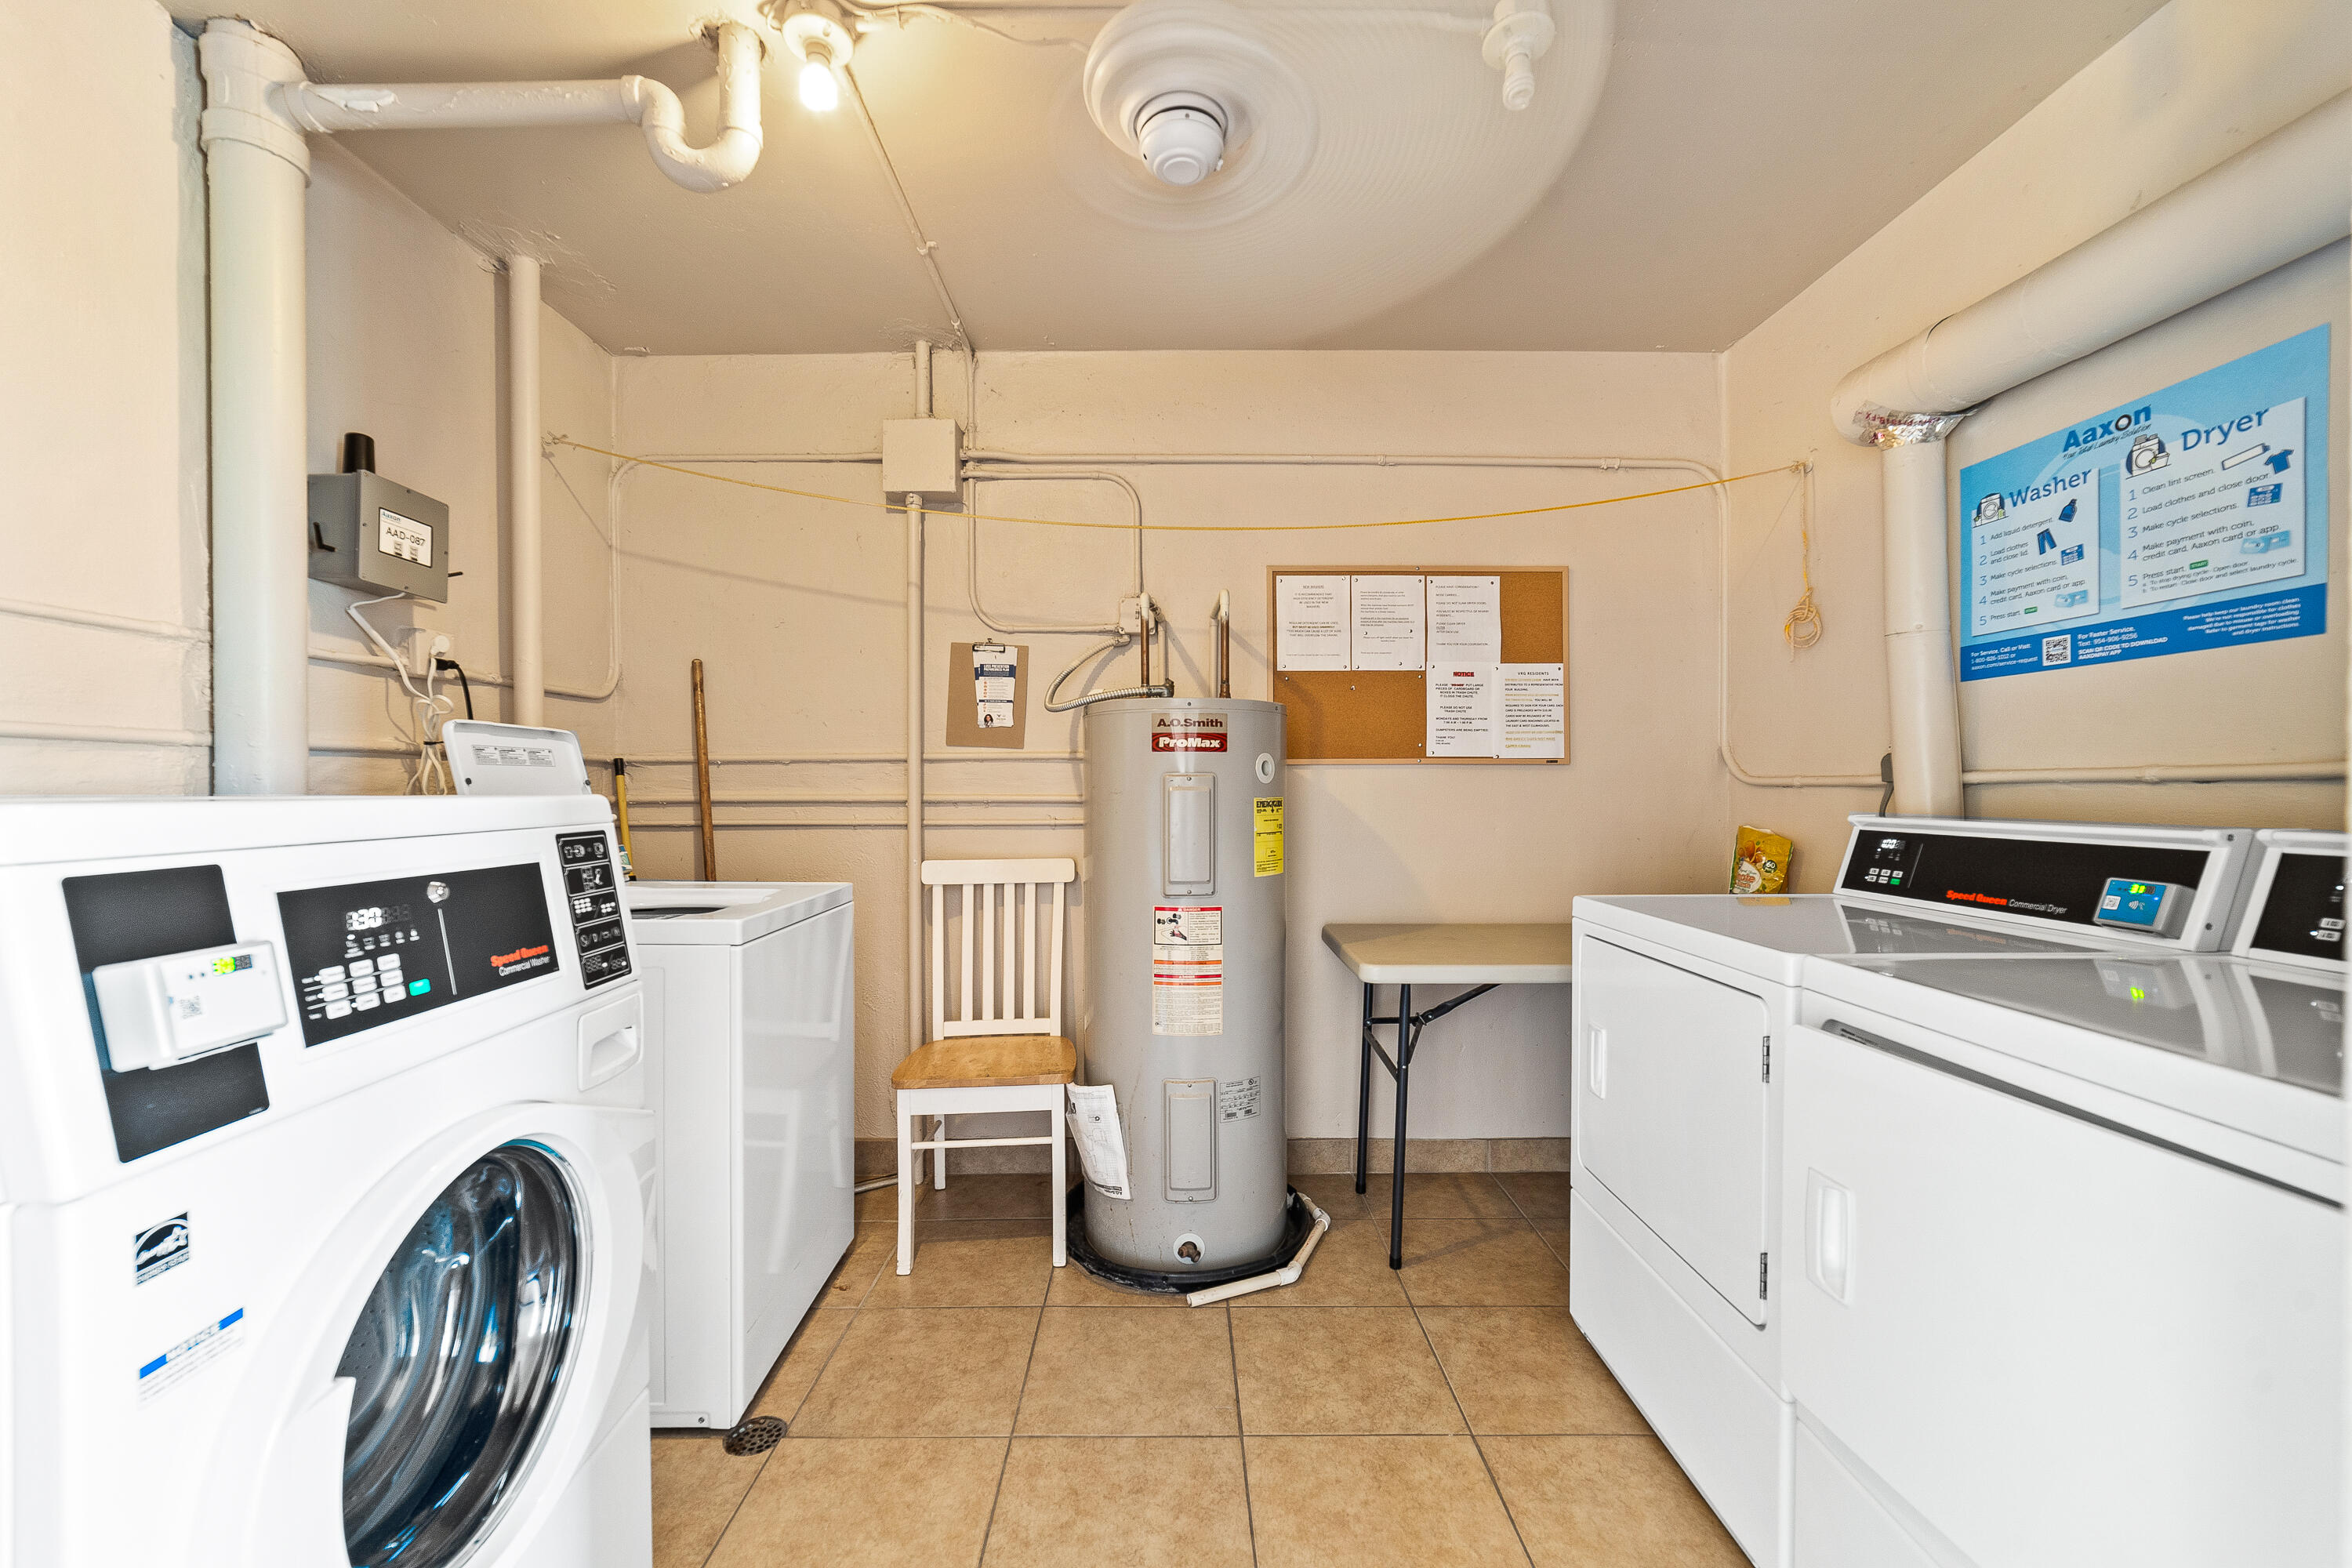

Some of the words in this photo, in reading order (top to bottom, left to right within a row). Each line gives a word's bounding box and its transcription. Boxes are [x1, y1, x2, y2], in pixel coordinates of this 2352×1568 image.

[2063, 406, 2151, 451] Aaxon
[2181, 409, 2267, 450] Dryer
[2009, 470, 2090, 506] Washer
[2129, 489, 2136, 500] 1
[2142, 483, 2165, 494] Clean
[2168, 477, 2180, 486] lint
[2127, 507, 2137, 519] 2
[2143, 503, 2162, 514] Load
[2165, 494, 2195, 506] clothes
[2198, 487, 2215, 497] and
[2218, 481, 2242, 492] close
[386, 527, 426, 546] AAD-087
[1980, 535, 1986, 545] 1
[2004, 527, 2020, 536] liquid
[2128, 526, 2137, 538] 3
[2143, 523, 2164, 532] Make
[2166, 516, 2188, 526] cycle
[2166, 532, 2204, 546] payment
[2208, 526, 2227, 535] with
[1980, 555, 1987, 565] 2
[1991, 547, 2005, 556] Load
[2006, 542, 2028, 551] clothes
[2127, 550, 2138, 559] 4
[2143, 550, 2165, 561] credit
[2191, 539, 2220, 549] Aaxon
[2222, 532, 2243, 542] card
[1980, 575, 1987, 585] 3
[2007, 582, 2034, 593] payment
[2129, 574, 2137, 586] 5
[1979, 595, 1987, 604] 4
[1980, 615, 1987, 626] 5
[2130, 637, 2168, 647] DOWNLOAD
[2078, 651, 2109, 659] AAXONPAY
[1157, 718, 1223, 728] A.O.Smith
[1158, 736, 1221, 749] ProMax
[1946, 890, 1976, 902] Speed
[1976, 893, 2008, 906] Queen
[2009, 898, 2047, 912] Commercial
[2047, 903, 2067, 915] Dryer
[490, 949, 521, 967] Speed
[520, 944, 548, 959] Queen
[499, 960, 532, 977] Commercial
[529, 956, 550, 967] Washer
